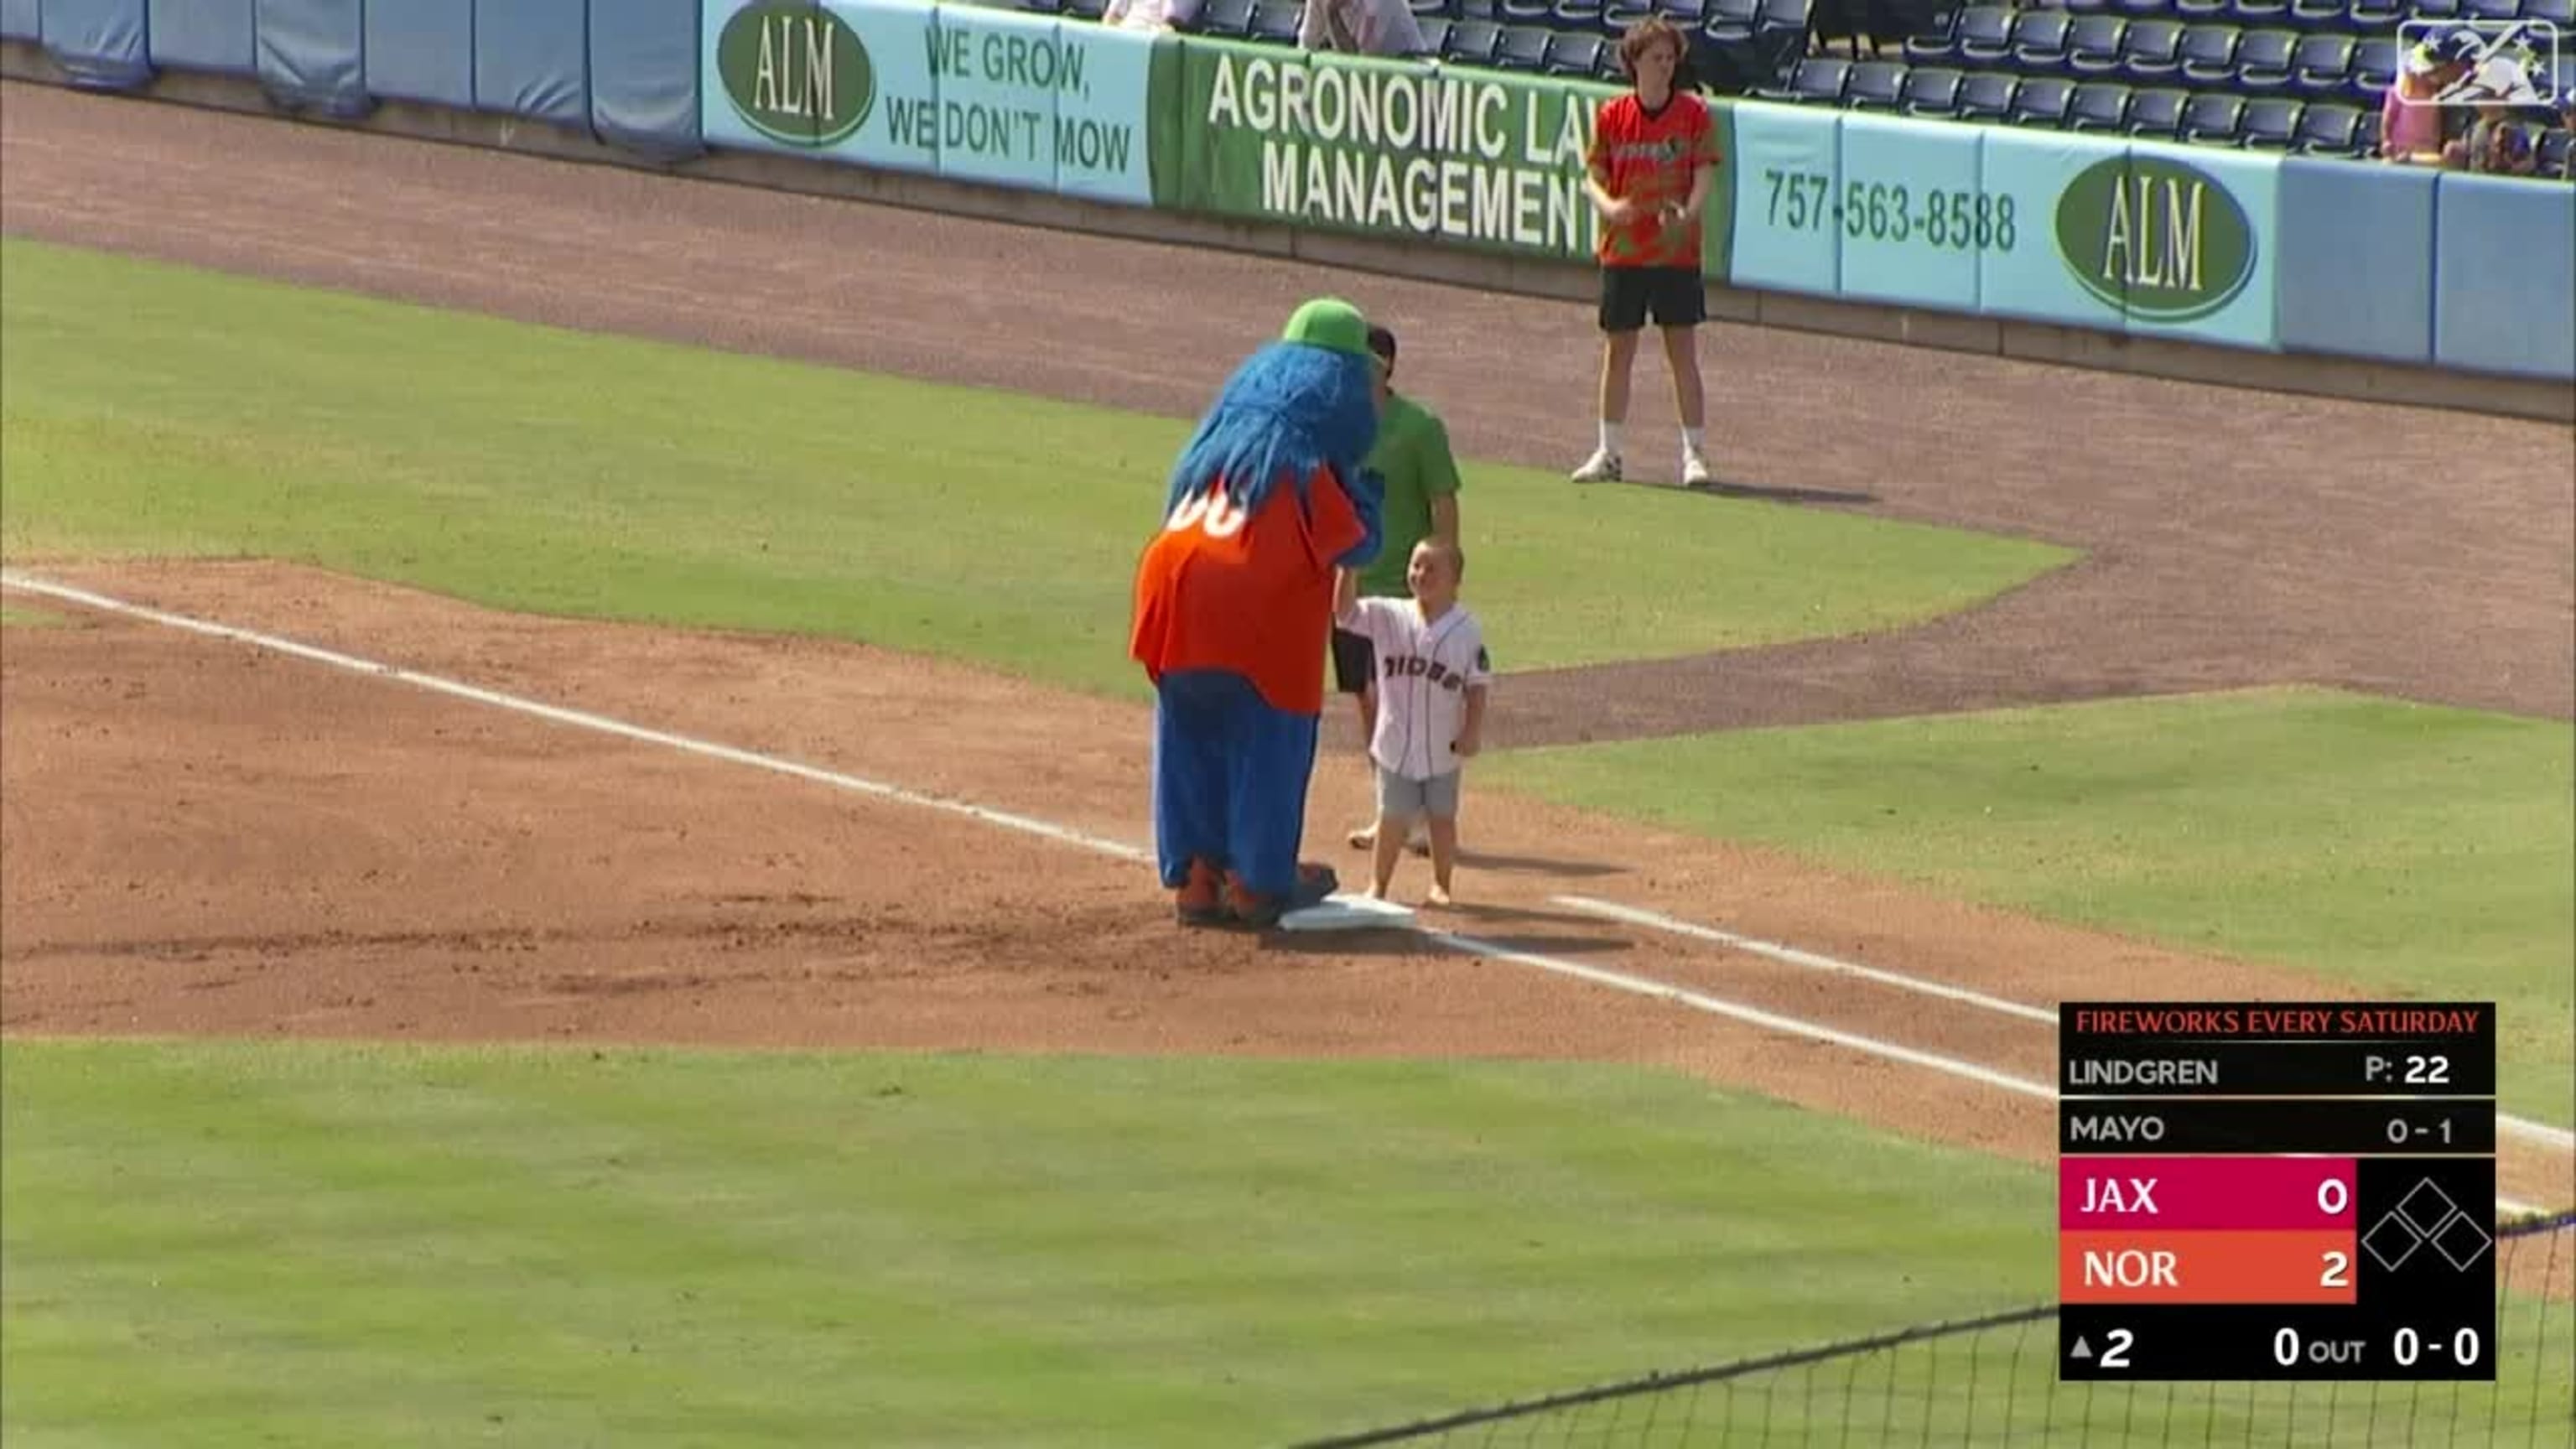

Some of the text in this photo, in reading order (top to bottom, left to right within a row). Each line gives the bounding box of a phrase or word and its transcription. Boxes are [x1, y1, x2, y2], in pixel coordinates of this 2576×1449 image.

[754, 14, 835, 121] ALM
[925, 23, 1091, 101] WE GROW,
[886, 96, 1131, 174] WE DON'T MOW
[1208, 53, 1598, 169] AGRONOMIC LA
[1764, 169, 2017, 251] 757-563-8588
[2102, 174, 2204, 290] ALM
